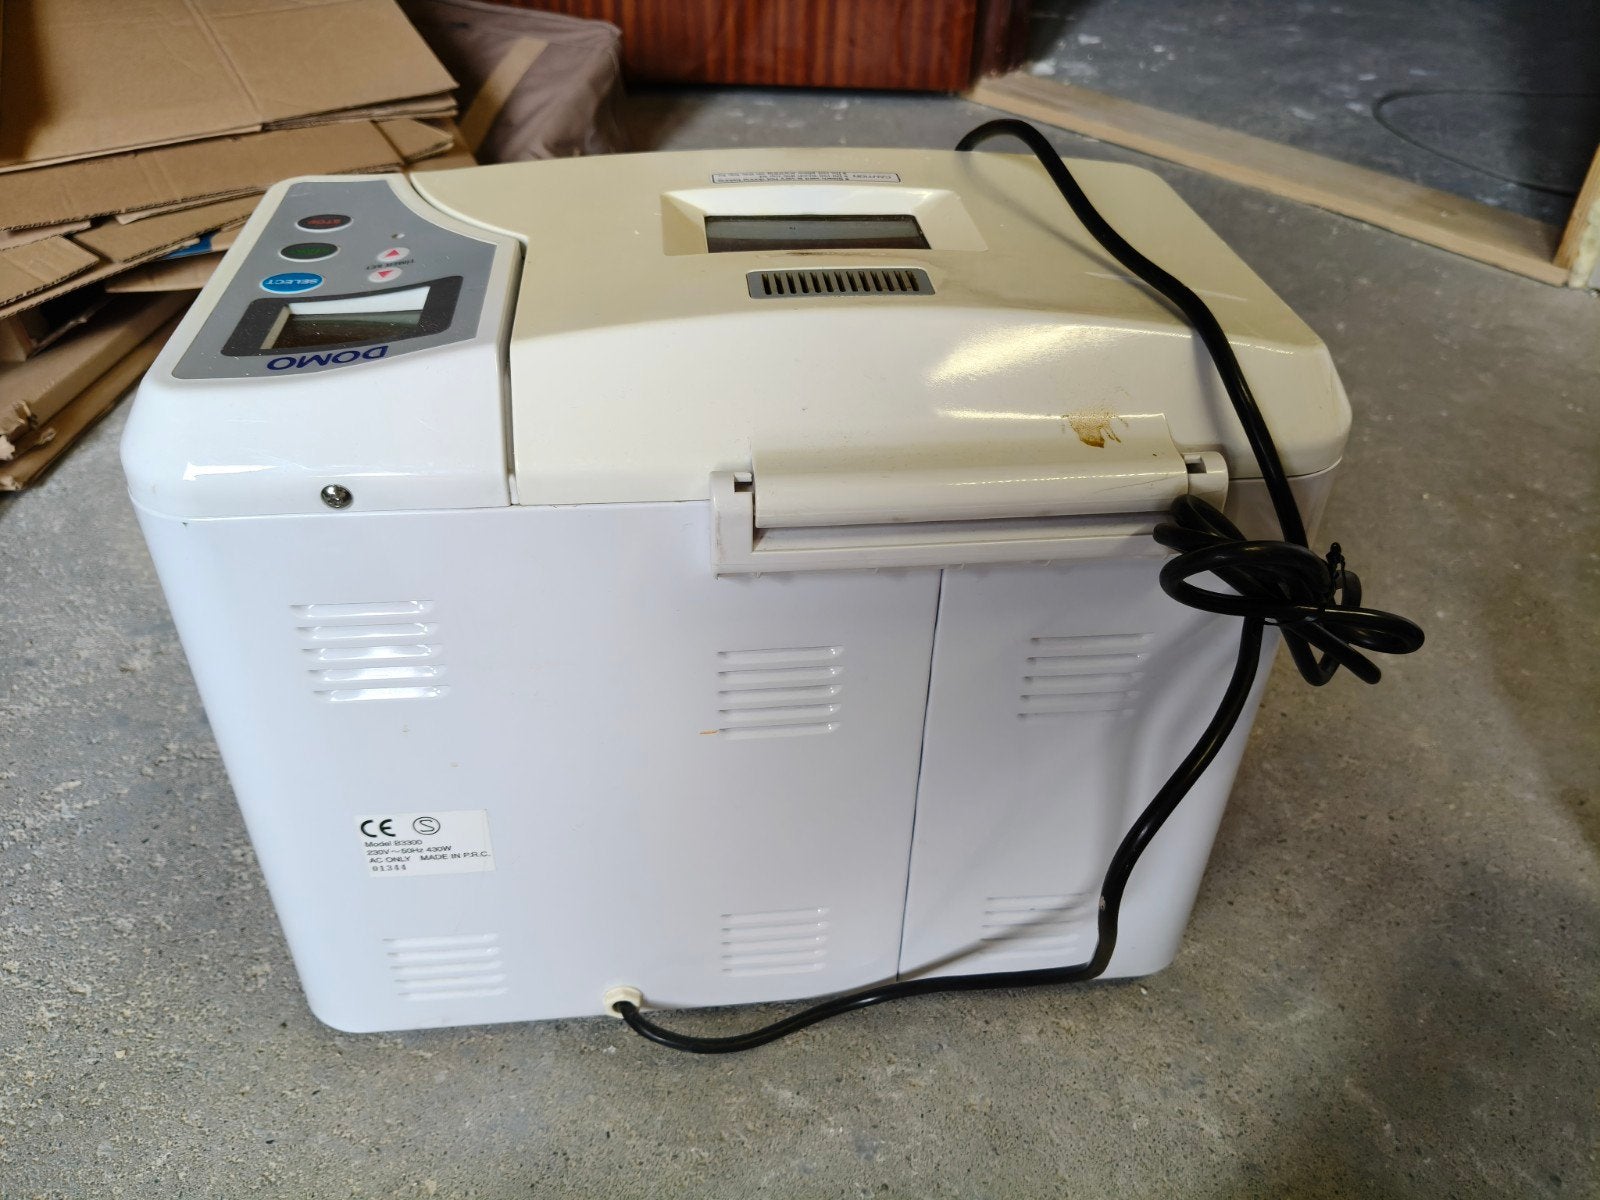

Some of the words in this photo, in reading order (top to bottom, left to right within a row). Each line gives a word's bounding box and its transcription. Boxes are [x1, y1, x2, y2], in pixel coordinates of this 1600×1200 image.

[265, 277, 319, 286] SELECT
[266, 345, 389, 371] DOMO
[365, 840, 392, 848] Model
[372, 864, 406, 872] 01344
